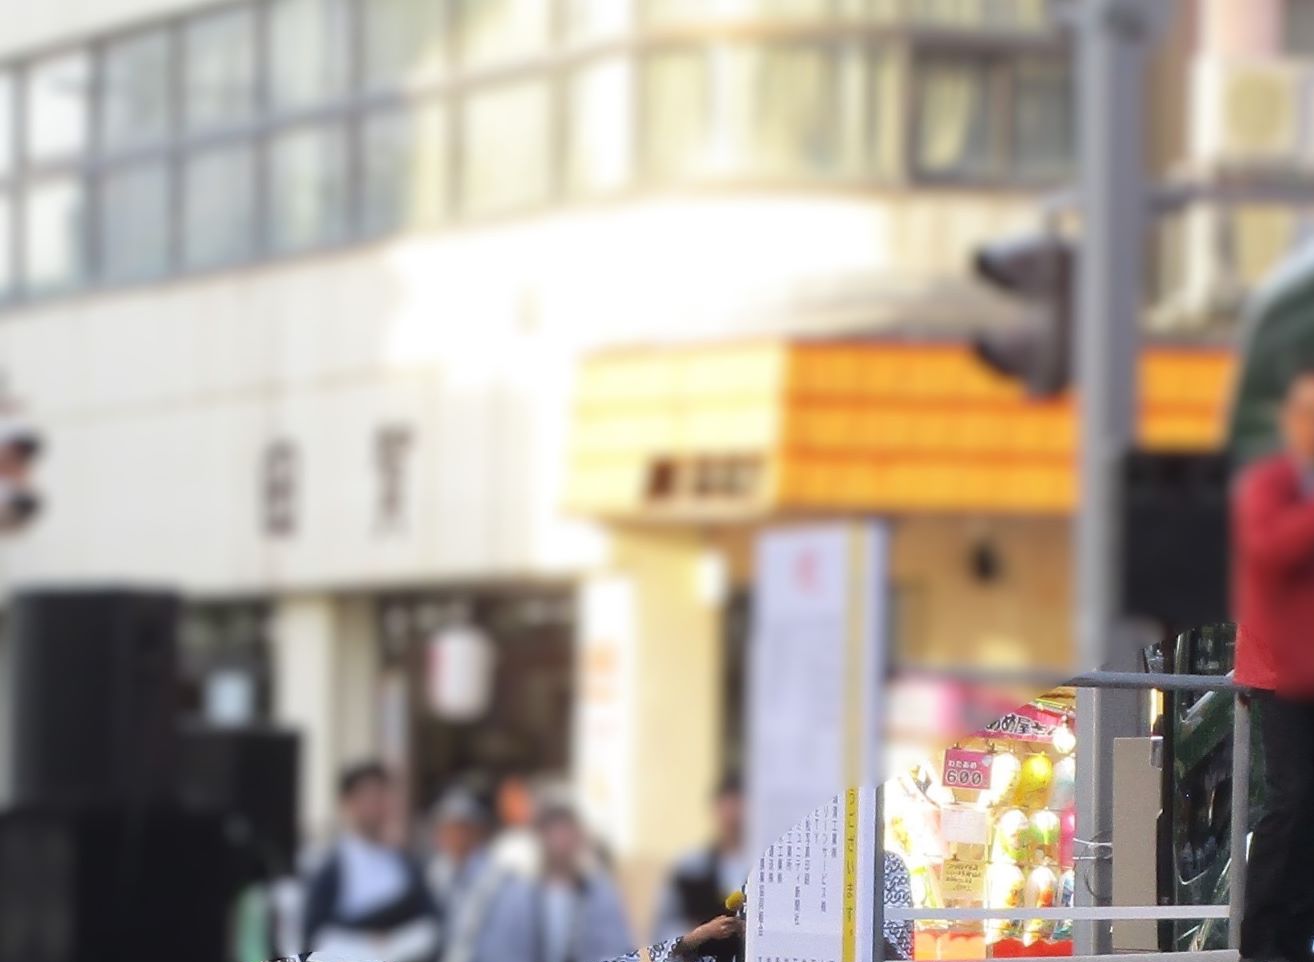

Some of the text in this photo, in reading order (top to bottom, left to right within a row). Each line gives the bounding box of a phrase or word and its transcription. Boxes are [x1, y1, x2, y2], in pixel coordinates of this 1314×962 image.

[985, 713, 1056, 736] め屋さ
[948, 760, 978, 769] わたあめ
[946, 770, 982, 785] 600
